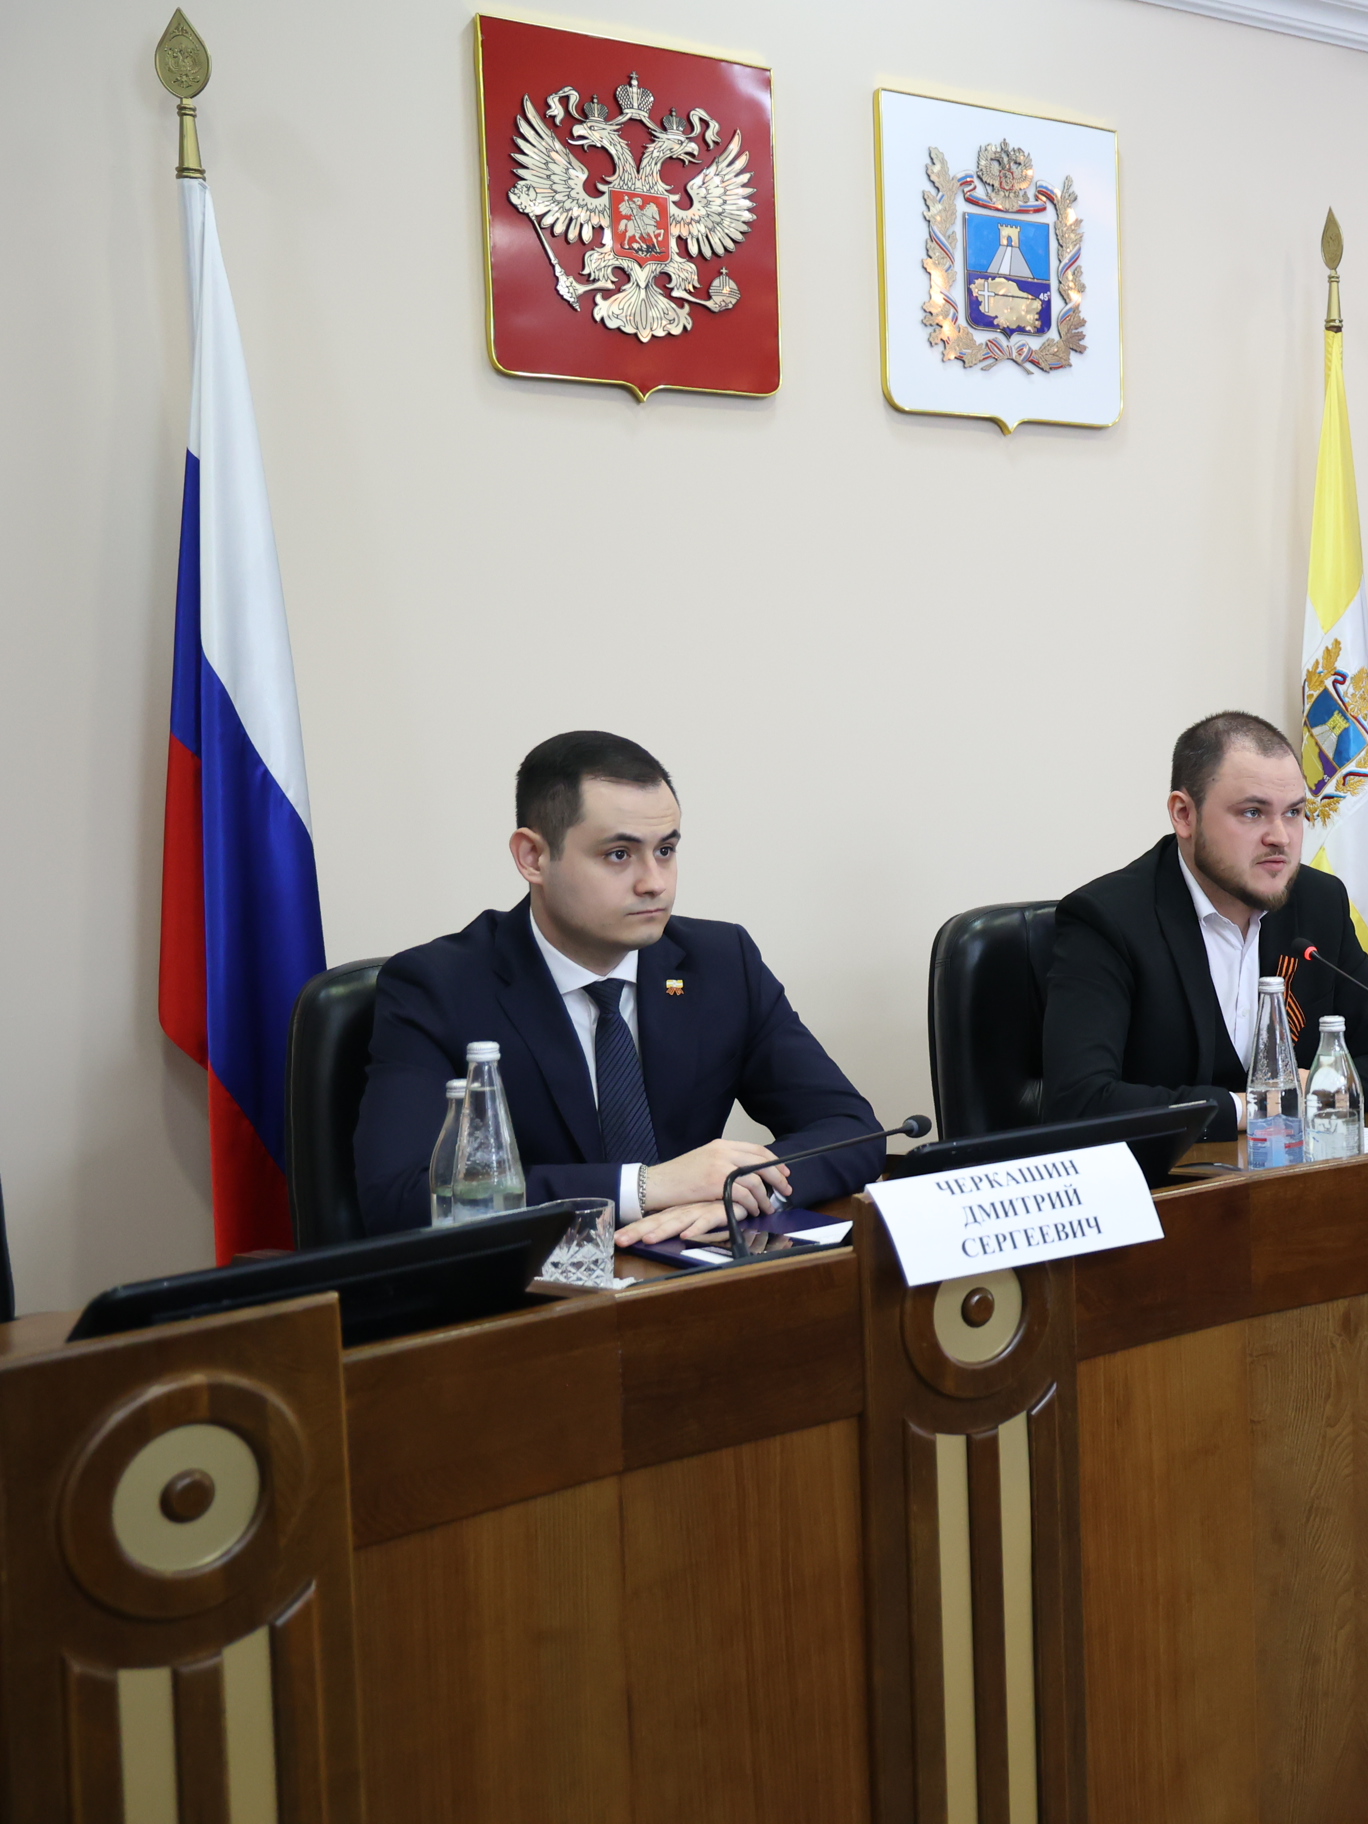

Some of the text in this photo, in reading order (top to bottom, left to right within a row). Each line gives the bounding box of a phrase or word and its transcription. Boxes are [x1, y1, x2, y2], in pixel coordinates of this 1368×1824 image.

[935, 1159, 1081, 1196] ЧЕРКАШИН
[963, 1184, 1084, 1229] ДМИТРИЙ
[961, 1216, 1104, 1258] СЕРГЕЕВИЧ
